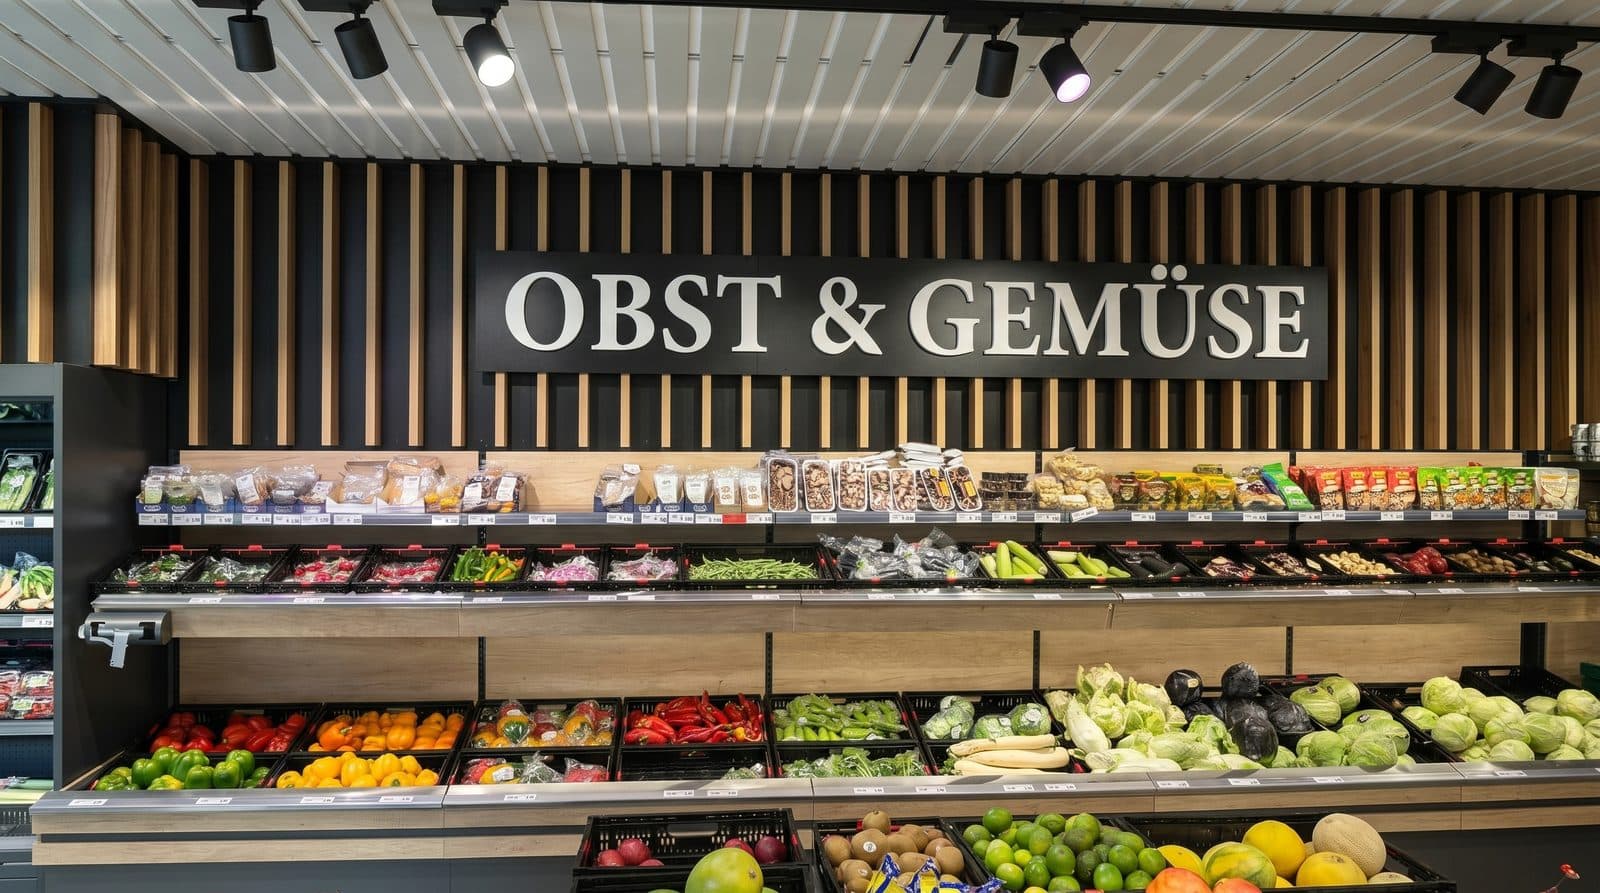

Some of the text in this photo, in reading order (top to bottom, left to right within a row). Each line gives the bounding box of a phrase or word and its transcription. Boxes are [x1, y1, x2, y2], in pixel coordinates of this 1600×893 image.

[505, 264, 1309, 359] OBST & GEMÜSE
